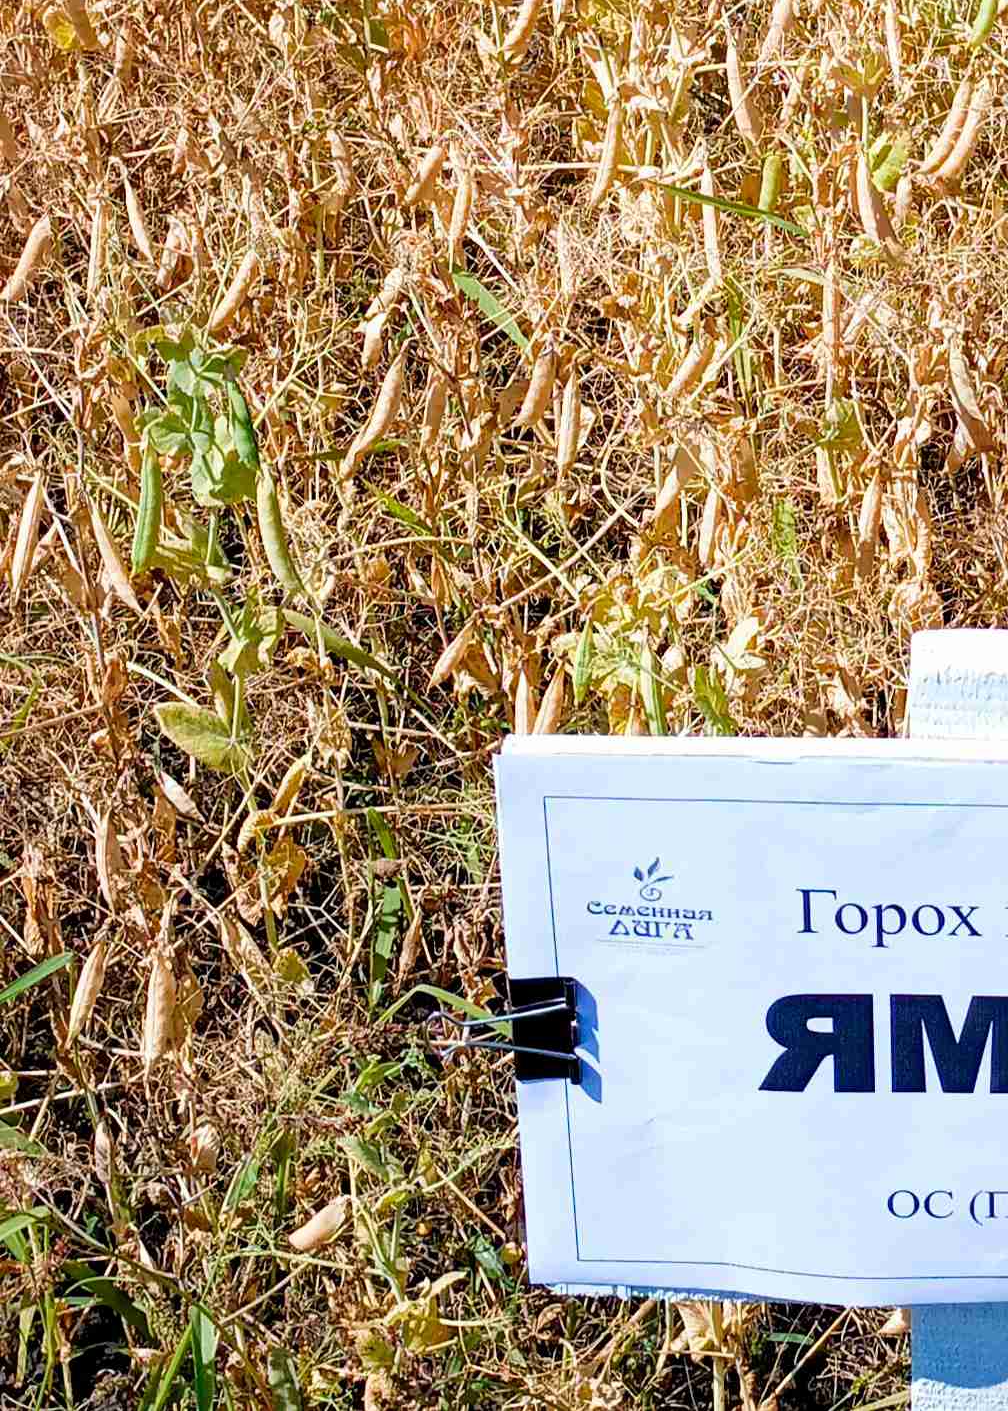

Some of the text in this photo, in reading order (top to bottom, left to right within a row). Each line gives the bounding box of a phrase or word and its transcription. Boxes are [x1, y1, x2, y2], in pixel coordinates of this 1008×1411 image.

[586, 900, 713, 921] Семенная
[796, 888, 983, 948] Горох
[887, 1189, 954, 1219] ОС
